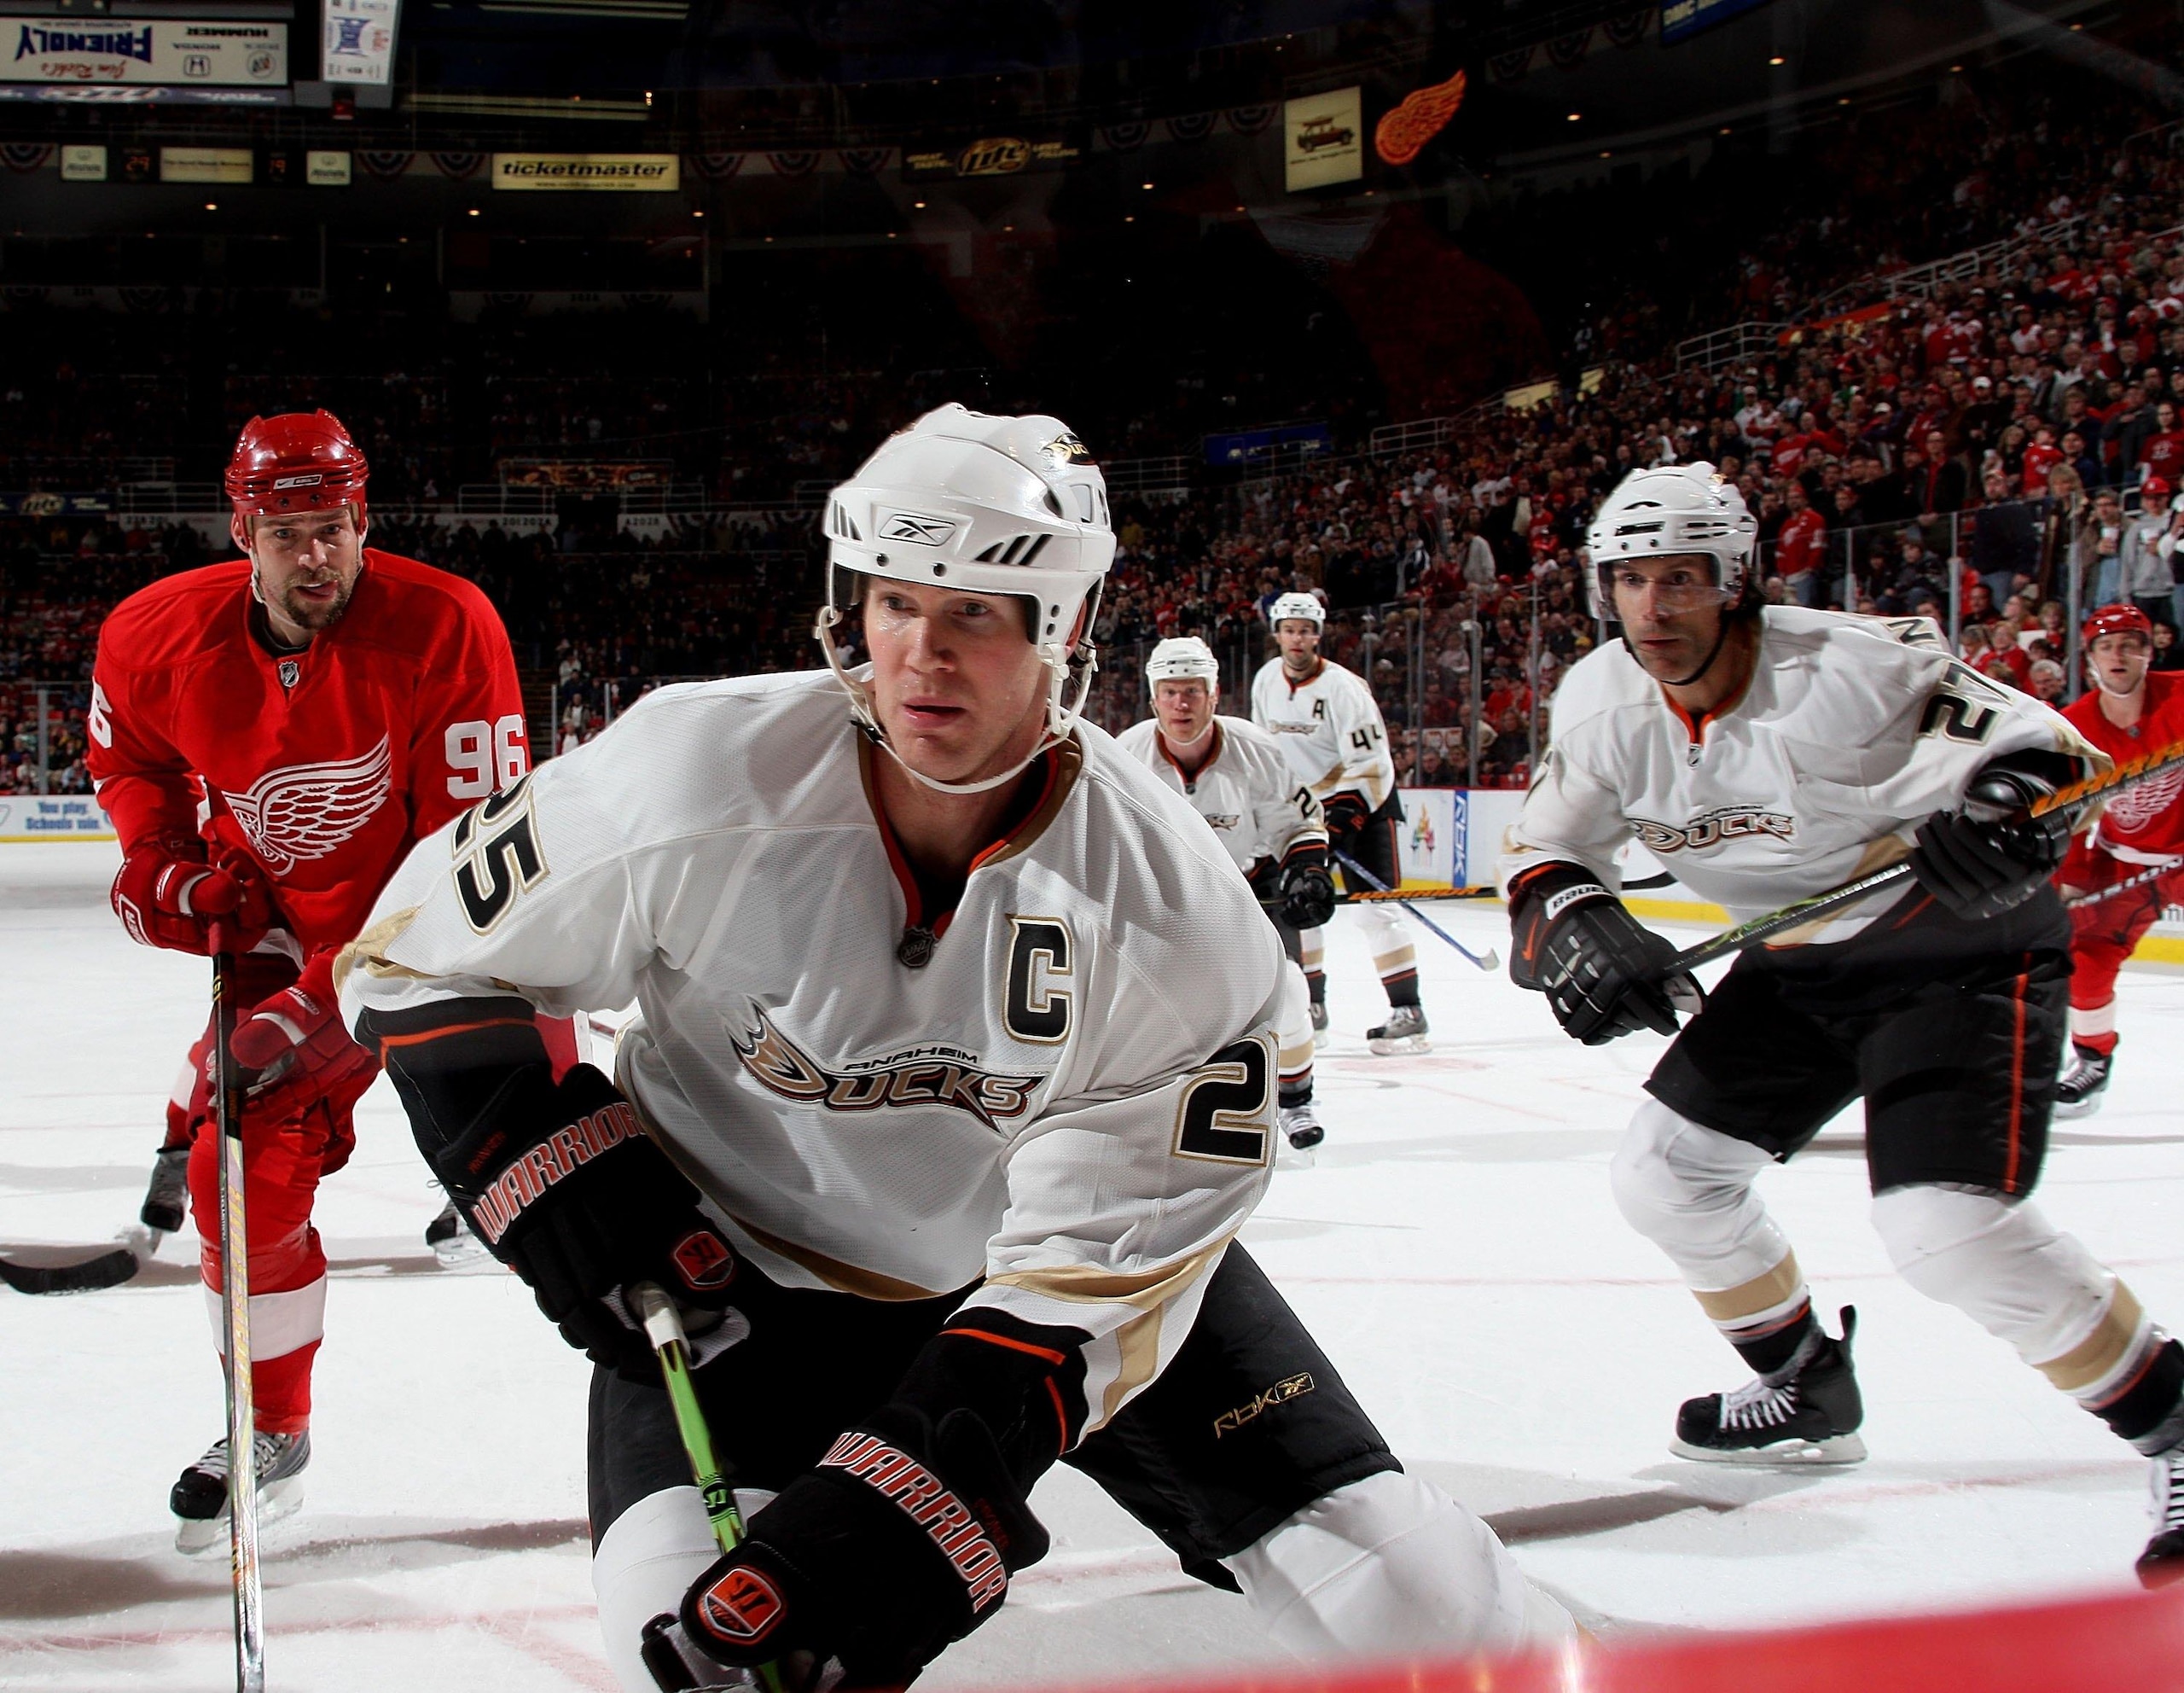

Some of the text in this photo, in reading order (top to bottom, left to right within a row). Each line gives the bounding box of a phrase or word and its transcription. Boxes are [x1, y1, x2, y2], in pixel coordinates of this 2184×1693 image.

[15, 24, 152, 63] FRIENDLY
[186, 26, 269, 37] HUMMER
[503, 161, 669, 176] ticketmaster
[1312, 699, 1325, 720] A
[444, 713, 526, 800] 96
[26, 816, 72, 829] Schools
[38, 801, 89, 816] You play.
[1626, 813, 1794, 852] DUCKS
[1002, 913, 1072, 1046] C
[727, 993, 1049, 1138] DUCKS
[843, 1045, 978, 1072] ANAHEIM
[470, 1102, 647, 1245] WARRIOR
[816, 1431, 1008, 1614] WARRIOR
